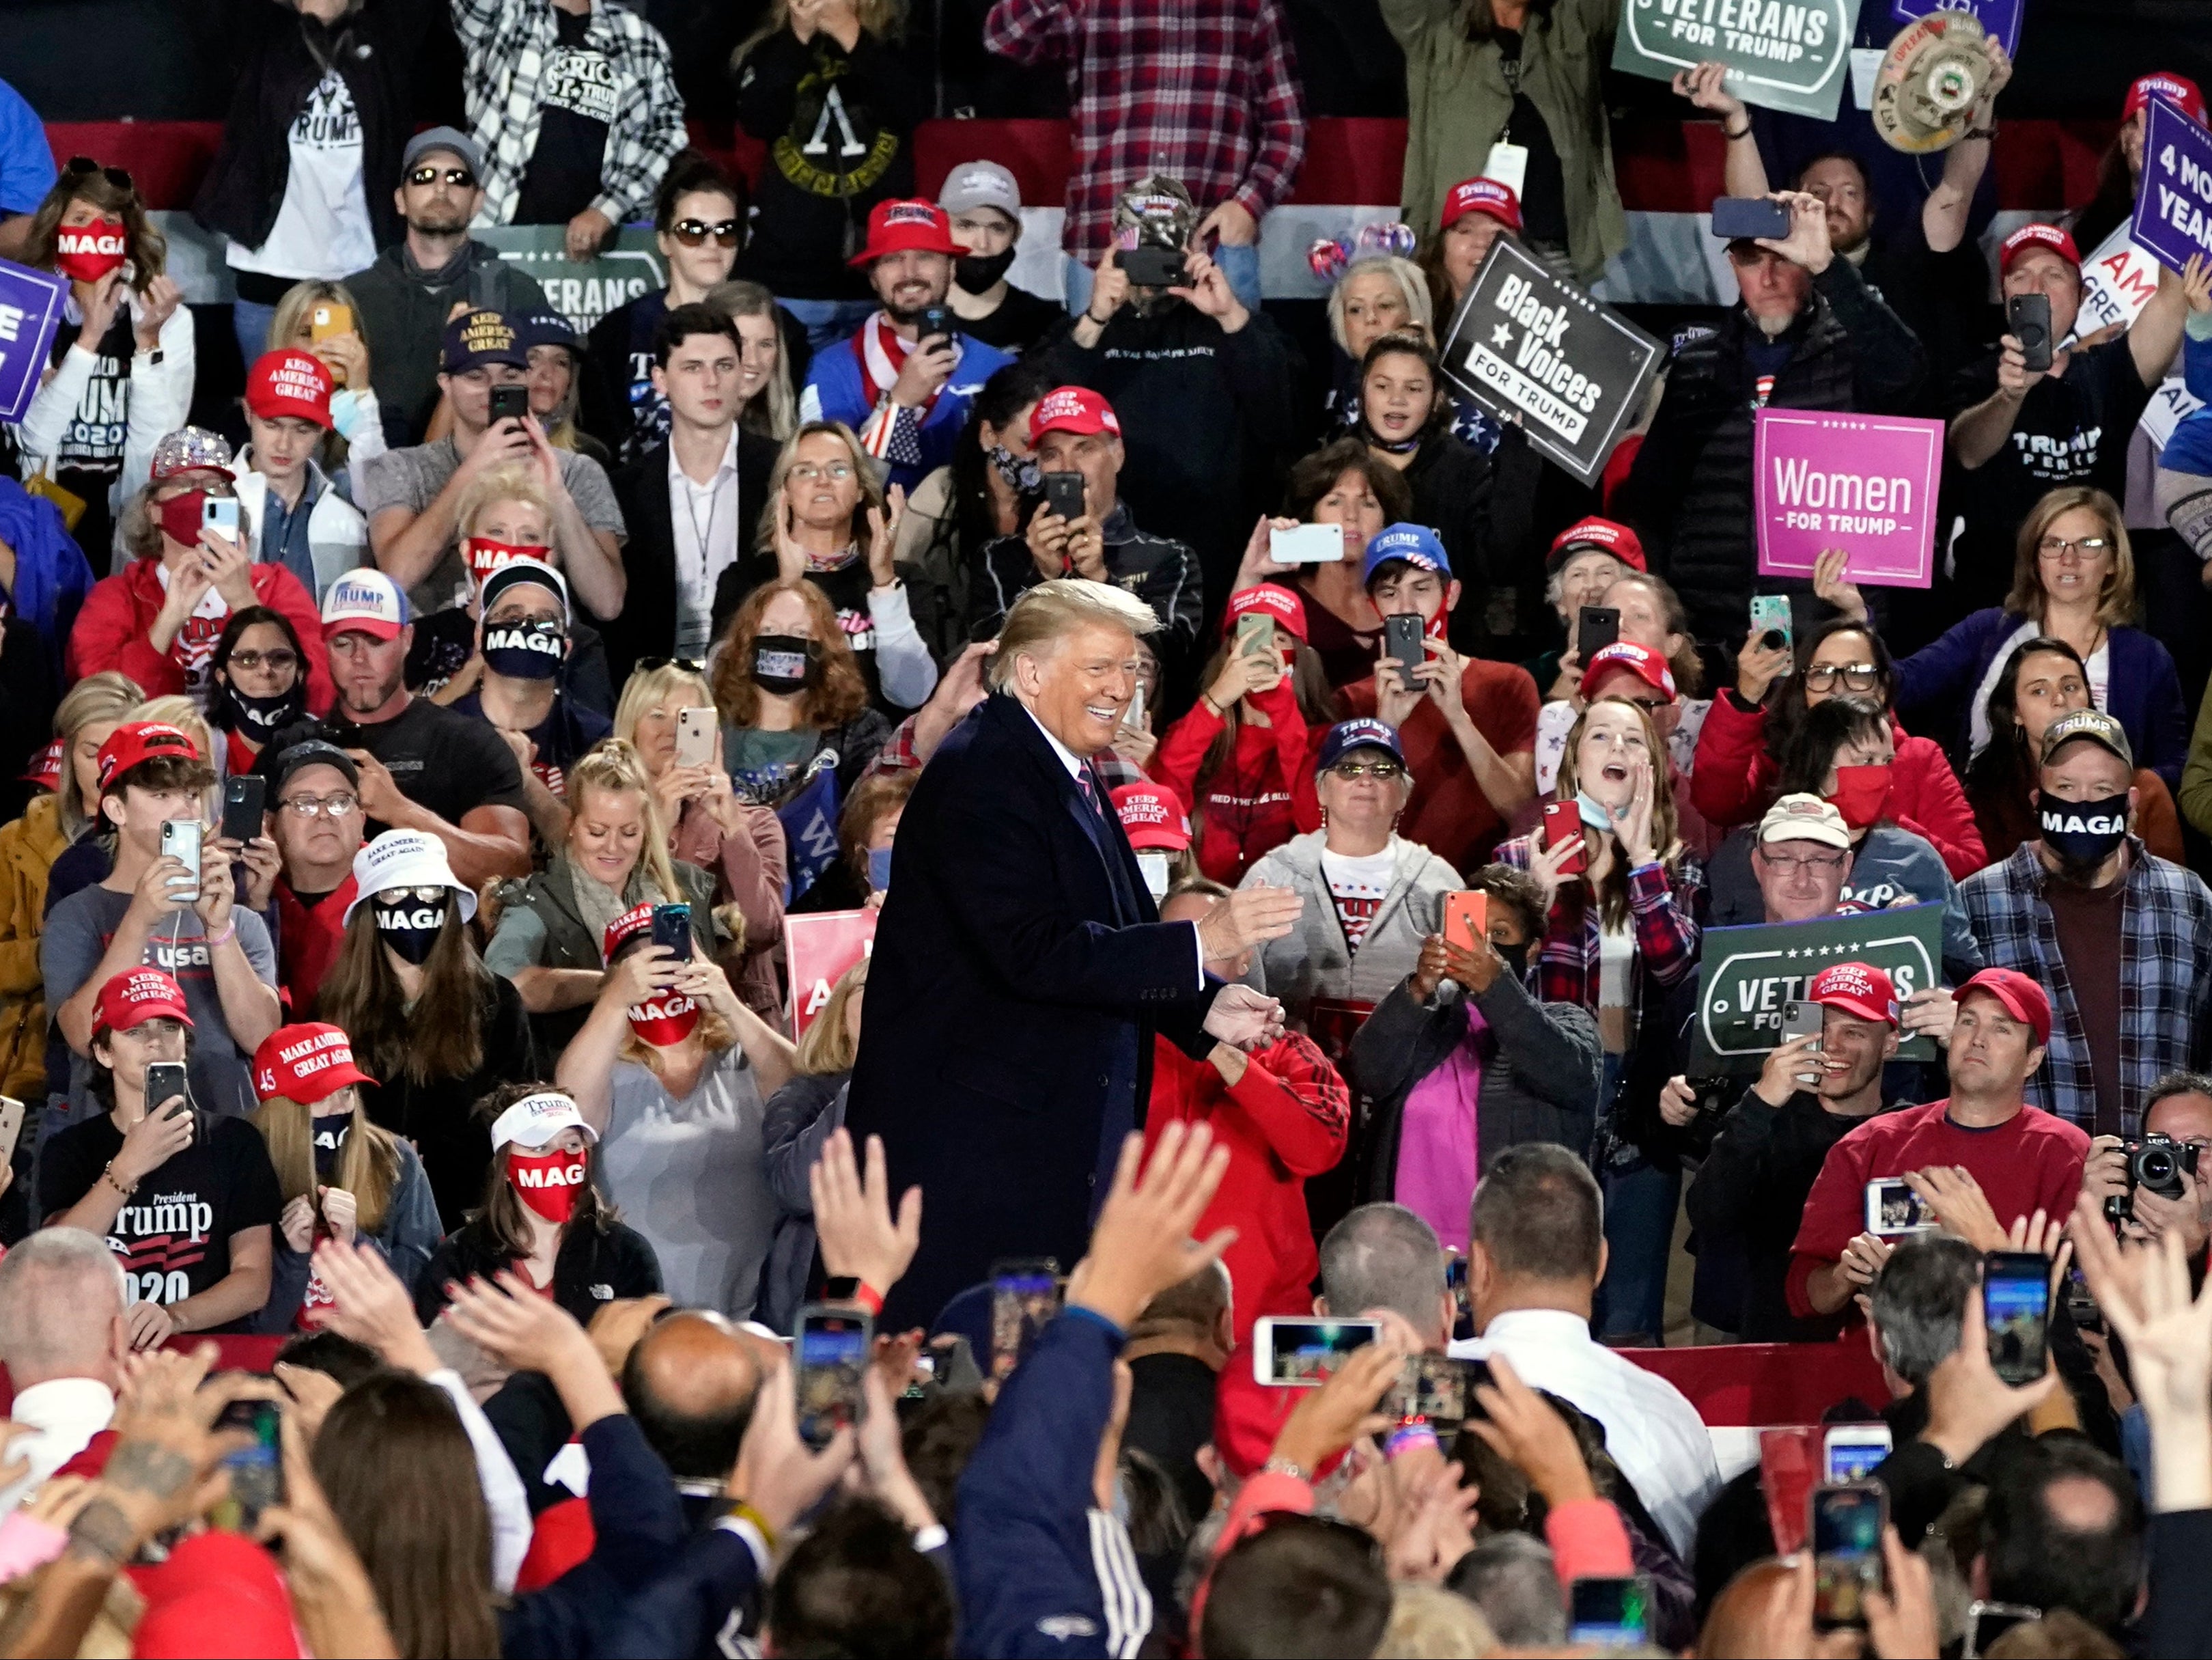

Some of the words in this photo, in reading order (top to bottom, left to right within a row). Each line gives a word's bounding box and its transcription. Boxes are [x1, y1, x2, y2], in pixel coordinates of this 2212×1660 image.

[1671, 18, 1716, 46] FOR
[1724, 29, 1803, 62] TRUMP
[2159, 145, 2175, 176] 4
[2180, 154, 2212, 204] MO
[1456, 181, 1509, 202] Trump
[2158, 183, 2212, 253] YEA
[58, 234, 126, 255] MAGA
[535, 277, 647, 315] ERANS
[471, 312, 503, 326] KEEP
[1494, 273, 1571, 348] Black
[460, 324, 516, 342] AMERICA
[468, 337, 510, 353] GREAT
[284, 358, 315, 374] KEEP
[1515, 331, 1602, 413] Voices
[268, 370, 325, 393] AMERICA
[275, 383, 318, 403] GREAT
[1474, 353, 1512, 388] FOR
[1515, 383, 1580, 432] TRUMP
[2013, 426, 2101, 458] TRUMP
[2022, 449, 2098, 471] PENCE
[1774, 456, 1912, 514] Women
[1787, 511, 1822, 531] FOR
[1828, 514, 1897, 536] TRUMP
[1376, 532, 1420, 553] TRUMP
[334, 588, 384, 605] TRUMP
[1256, 590, 1296, 609] AMERICA
[486, 629, 561, 659] MAGA
[1596, 643, 1649, 661] Trump
[1340, 719, 1392, 738] TRUMP
[2054, 715, 2111, 736] TRUMP
[1125, 794, 1159, 807] KEEP
[1209, 793, 1231, 805] RED
[1233, 795, 1257, 807] WHIT
[1271, 792, 1291, 802] BLU
[1117, 803, 1169, 818] AMERICA
[1122, 812, 1162, 825] GREAT
[2041, 810, 2125, 835] MAGA
[389, 837, 427, 848] AMERICA
[372, 850, 395, 868] GREAT
[398, 846, 425, 856] AGAIN
[375, 908, 445, 930] MAGA
[157, 945, 210, 969] usa
[127, 973, 164, 988] KEEP
[1819, 972, 1873, 995] AMERICA
[1831, 967, 1868, 979] KEEP
[120, 983, 179, 999] AMERICA
[129, 989, 175, 1004] GREAT
[1821, 983, 1866, 998] GREAT
[628, 996, 695, 1022] MAGA
[1753, 1012, 1782, 1031] FO
[279, 1038, 314, 1064] MAKE
[293, 1054, 331, 1079] GREAT
[260, 1067, 277, 1092] 45
[2147, 1137, 2170, 1146] LEICA
[518, 1163, 585, 1188] MAG
[153, 1192, 197, 1204] President
